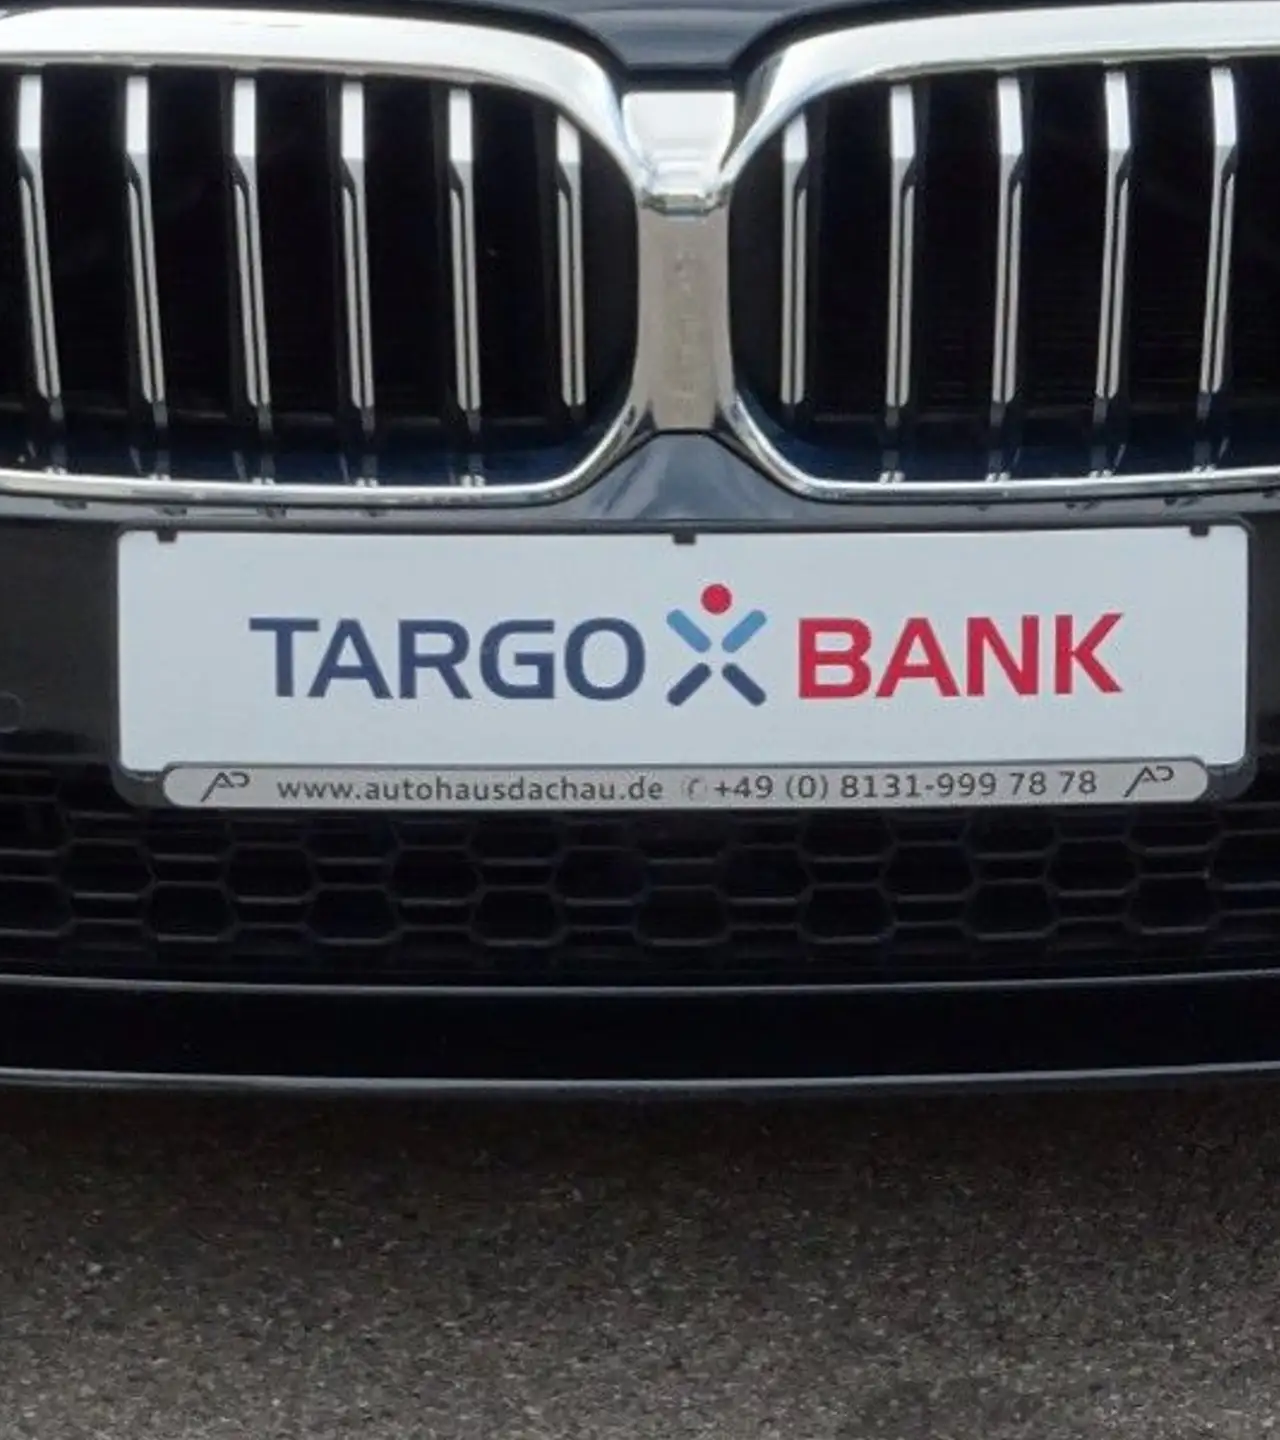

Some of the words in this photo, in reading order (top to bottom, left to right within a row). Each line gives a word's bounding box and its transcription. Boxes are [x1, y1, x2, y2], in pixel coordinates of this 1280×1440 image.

[277, 774, 664, 802] www.autohausdachau.de
[714, 774, 774, 799] +49
[785, 773, 829, 801] (0)
[840, 771, 997, 799] 8131-999
[1009, 770, 1048, 797] 78
[1059, 770, 1098, 796] 78
